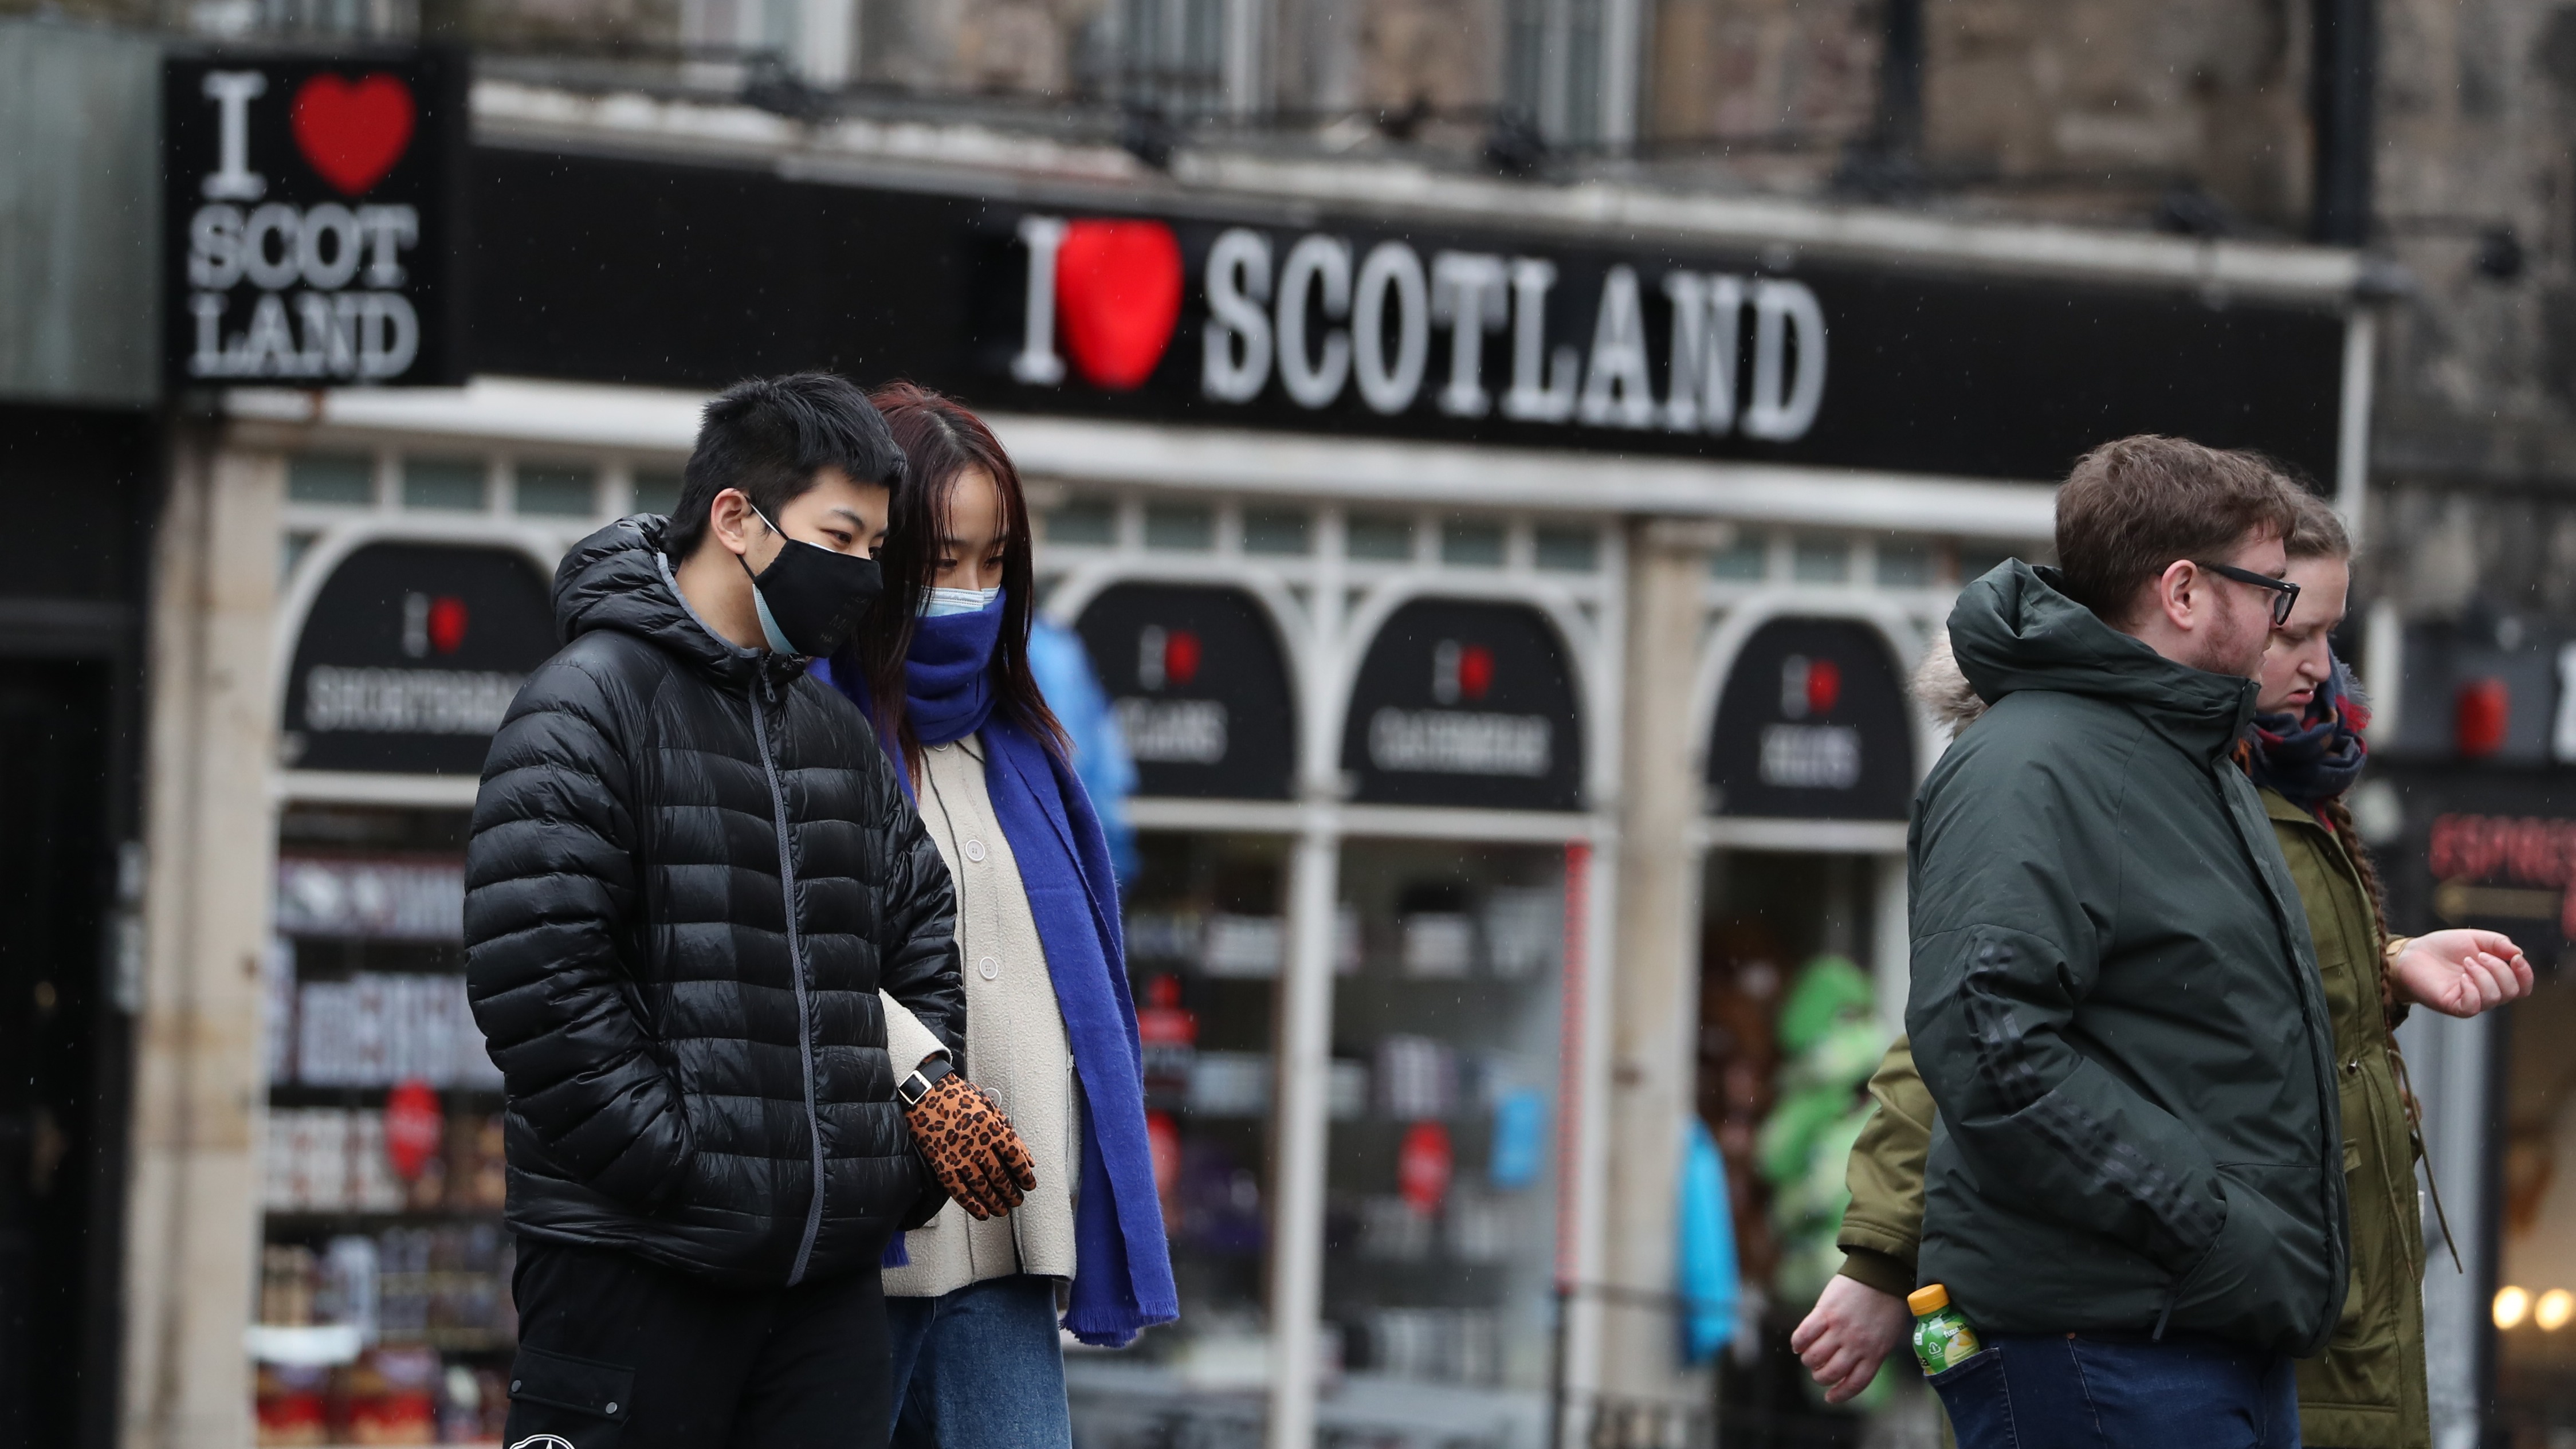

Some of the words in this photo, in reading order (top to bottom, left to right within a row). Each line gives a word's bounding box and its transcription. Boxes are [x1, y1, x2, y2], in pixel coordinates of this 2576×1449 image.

[203, 72, 266, 199] I
[189, 202, 419, 289] SCOT
[189, 290, 419, 378] LAND
[1013, 218, 1067, 384] I
[1203, 230, 1828, 441] SCOTLAND
